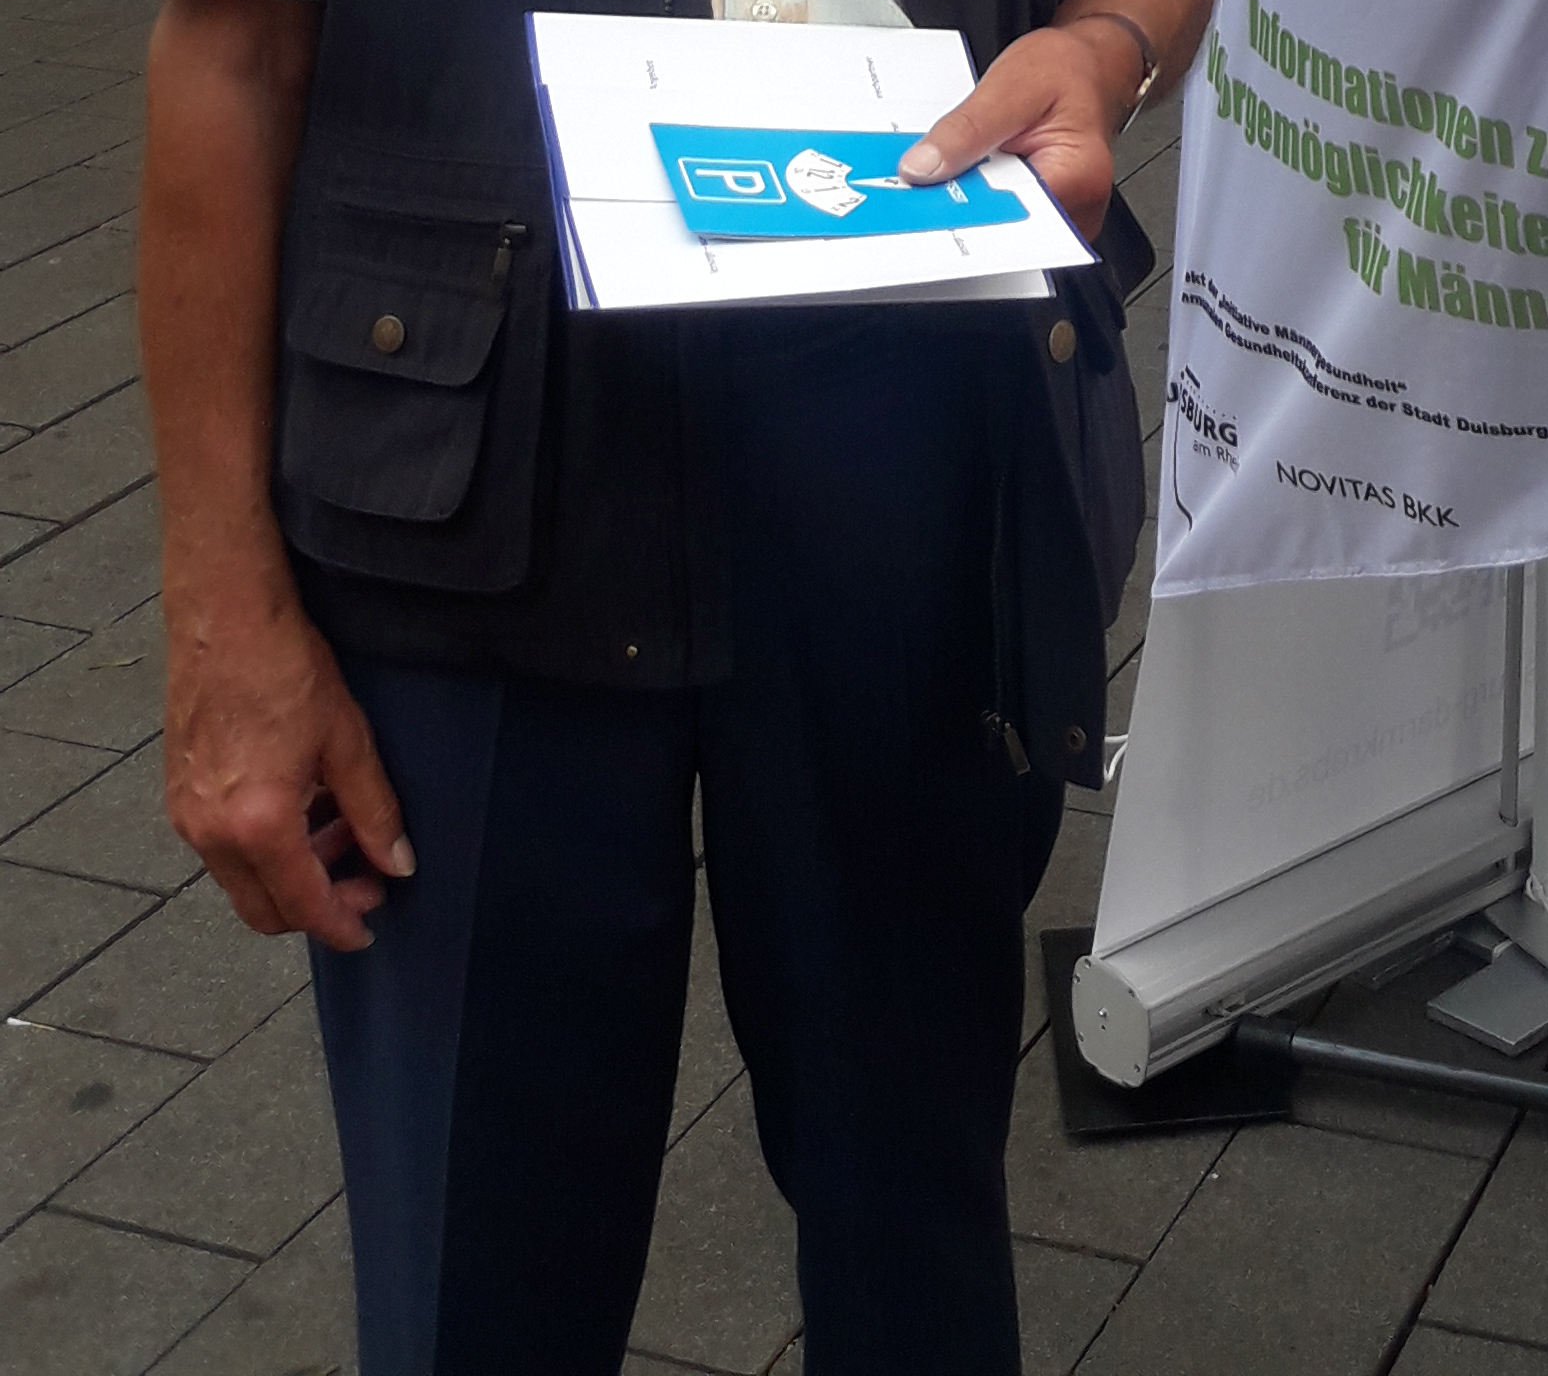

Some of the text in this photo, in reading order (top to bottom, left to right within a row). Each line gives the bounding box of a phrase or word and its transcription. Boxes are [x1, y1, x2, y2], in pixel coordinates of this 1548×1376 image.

[694, 168, 766, 195] P
[1343, 216, 1390, 296] für
[1366, 394, 1397, 413] der
[1402, 401, 1452, 429] Stadt
[1276, 460, 1461, 528] NOVITAS BKK
